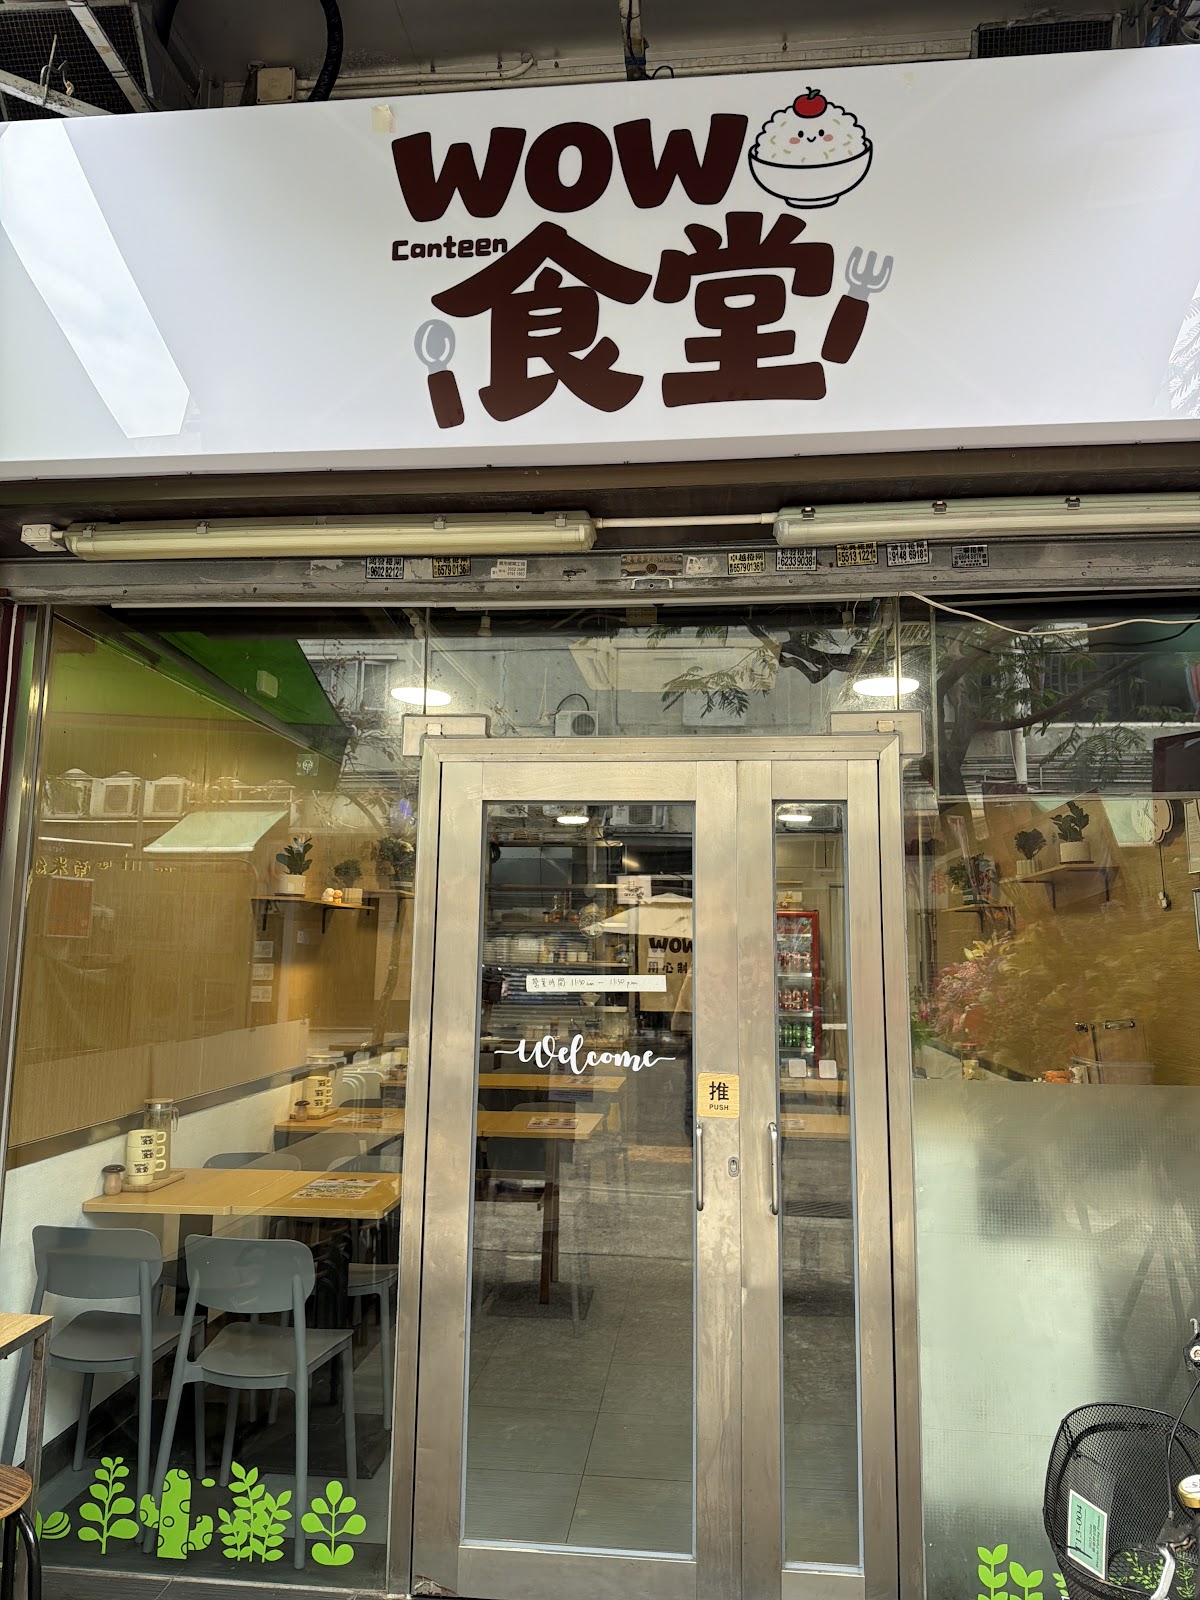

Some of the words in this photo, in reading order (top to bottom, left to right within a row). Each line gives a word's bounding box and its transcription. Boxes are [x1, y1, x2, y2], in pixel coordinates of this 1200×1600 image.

[391, 113, 748, 222] WOW
[391, 235, 508, 261] Canteen
[431, 211, 835, 421] 食堂
[648, 937, 692, 953] WOW
[494, 1033, 676, 1075] Welcome
[708, 1081, 730, 1101] 推
